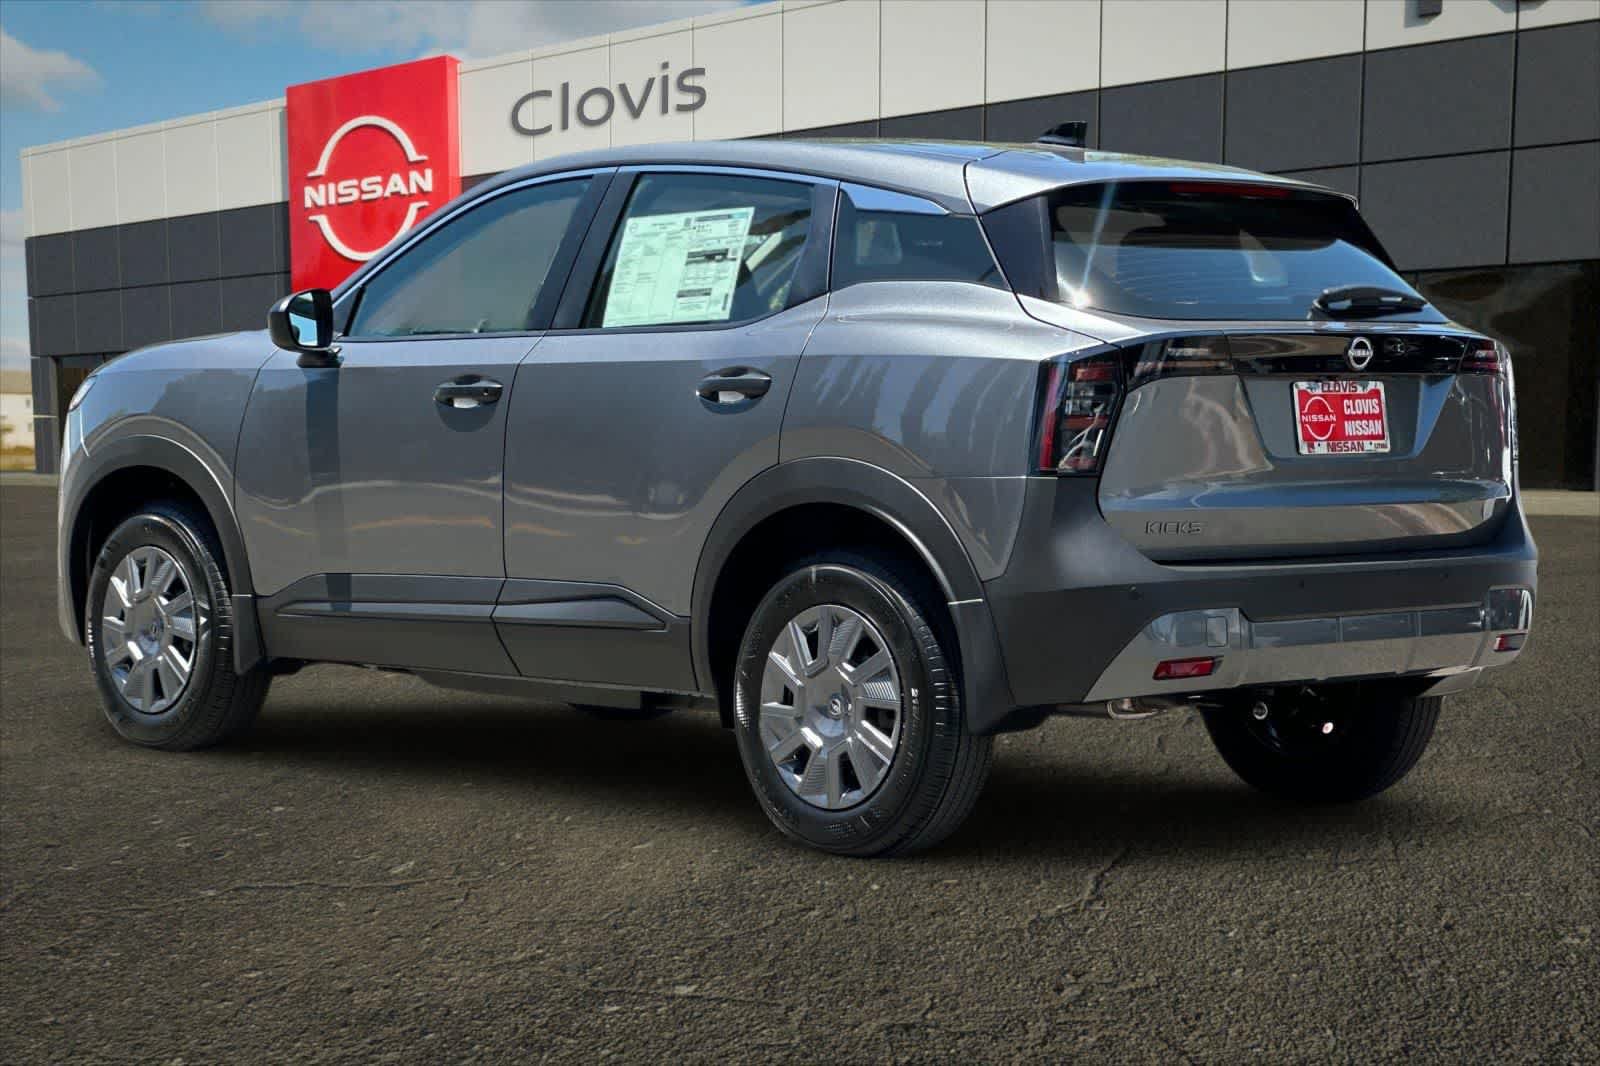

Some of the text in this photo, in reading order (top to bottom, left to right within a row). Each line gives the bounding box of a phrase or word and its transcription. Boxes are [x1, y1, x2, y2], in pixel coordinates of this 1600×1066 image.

[511, 61, 708, 136] Clovis
[304, 168, 433, 208] NISSAN
[1321, 381, 1357, 392] CLOVIS
[1343, 398, 1380, 415] CLOVIS
[1301, 414, 1336, 422] NISSAN
[1344, 419, 1382, 436] NISSAN
[1327, 441, 1365, 452] NISSAN
[1144, 520, 1203, 536] KICKS
